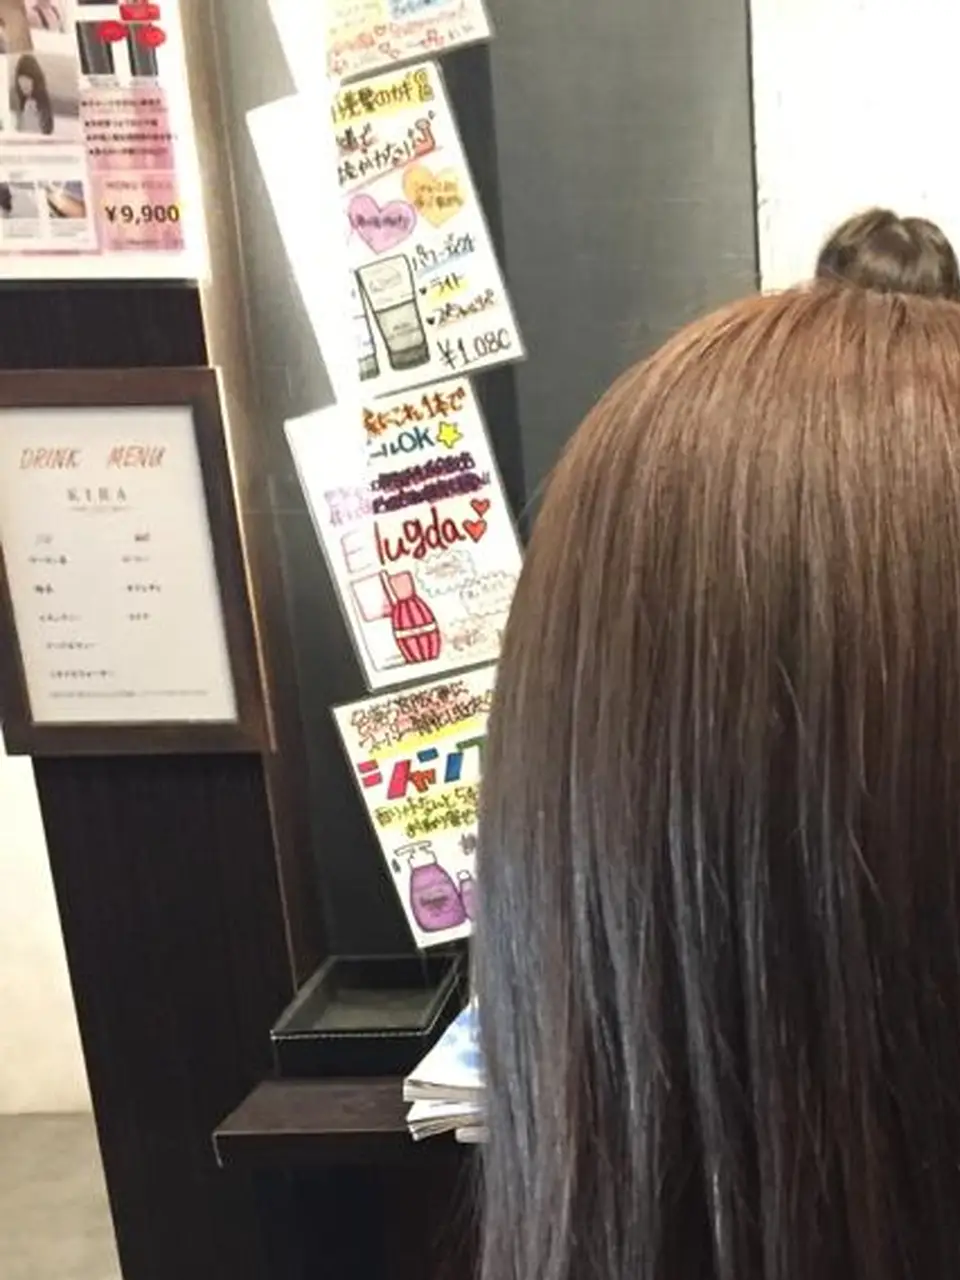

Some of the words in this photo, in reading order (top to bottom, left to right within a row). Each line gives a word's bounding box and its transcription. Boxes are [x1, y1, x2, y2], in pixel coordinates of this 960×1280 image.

[105, 204, 180, 224] ¥9,900
[19, 447, 83, 470] DRINK
[106, 444, 167, 469] MENU
